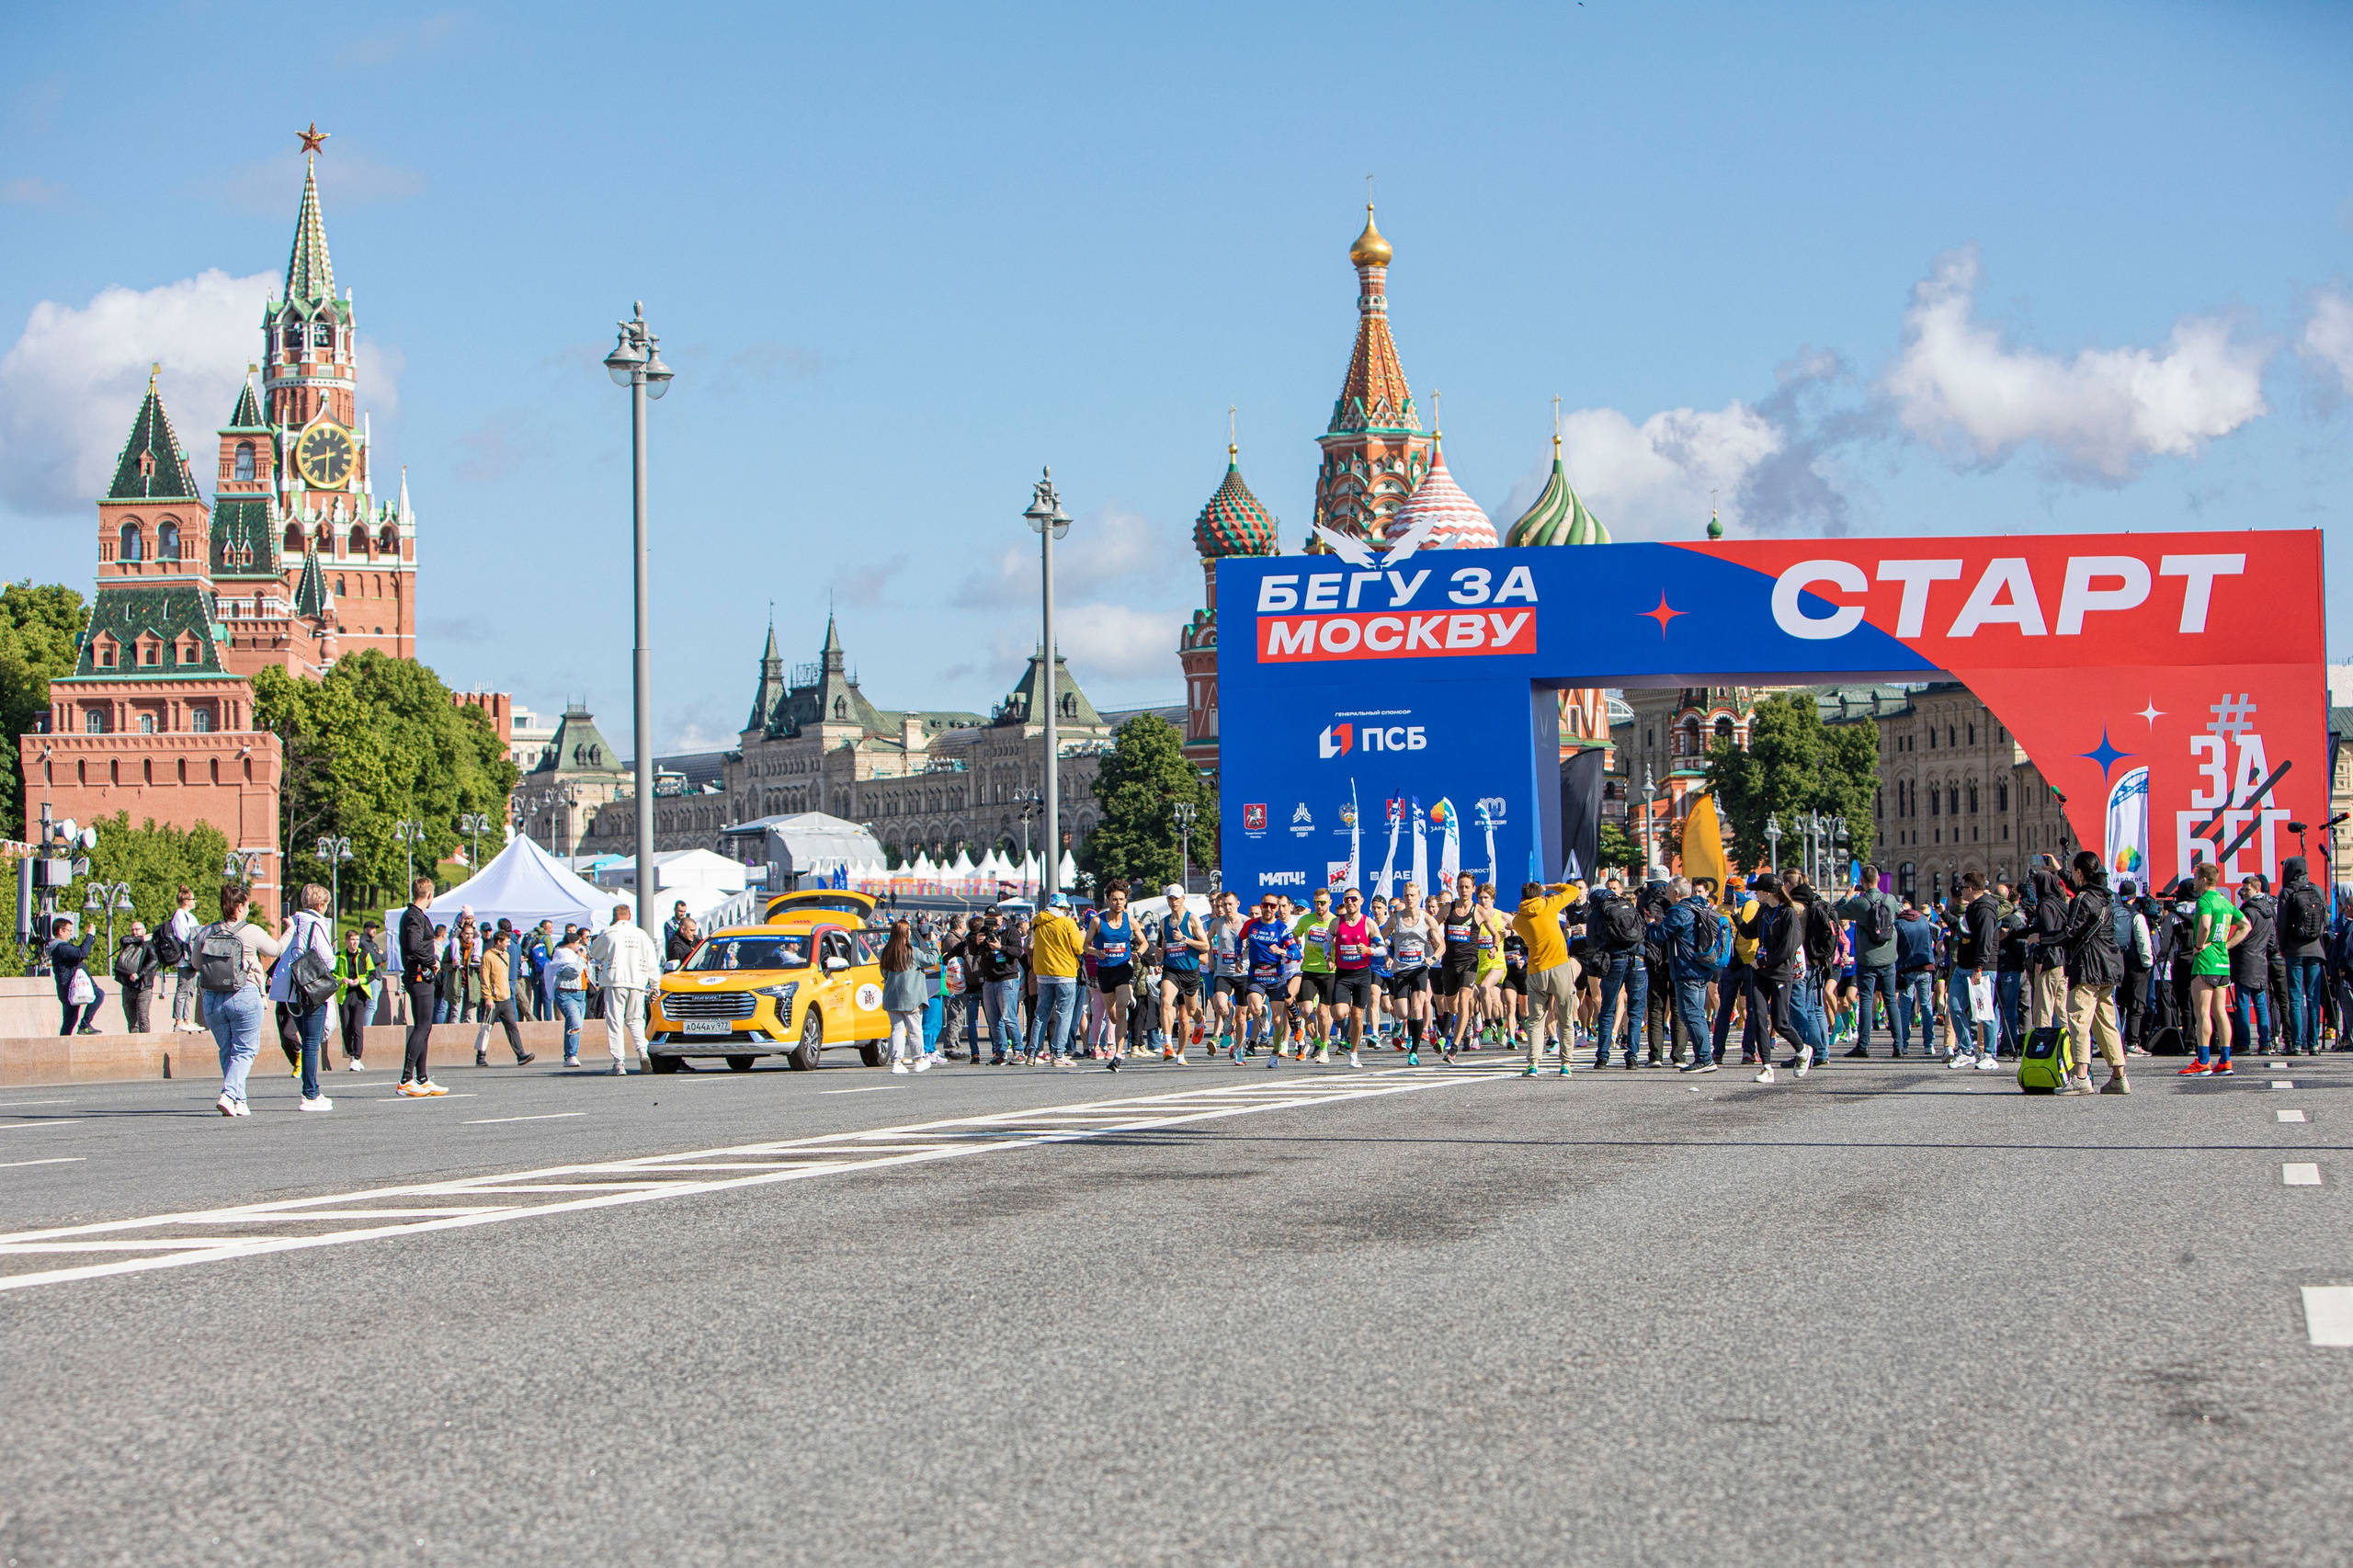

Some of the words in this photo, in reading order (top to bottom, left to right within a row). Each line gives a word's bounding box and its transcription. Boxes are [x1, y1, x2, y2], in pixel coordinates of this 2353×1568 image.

[1256, 569, 1432, 612] БЕГУ
[1448, 566, 1539, 605] ЗА
[1771, 553, 2246, 640] СТАРТ
[1267, 612, 1530, 655] МОСКВУ
[1362, 726, 1427, 751] ПСБ
[1259, 871, 1306, 886] МАТЧ!
[1248, 933, 1279, 943] RUSSIA
